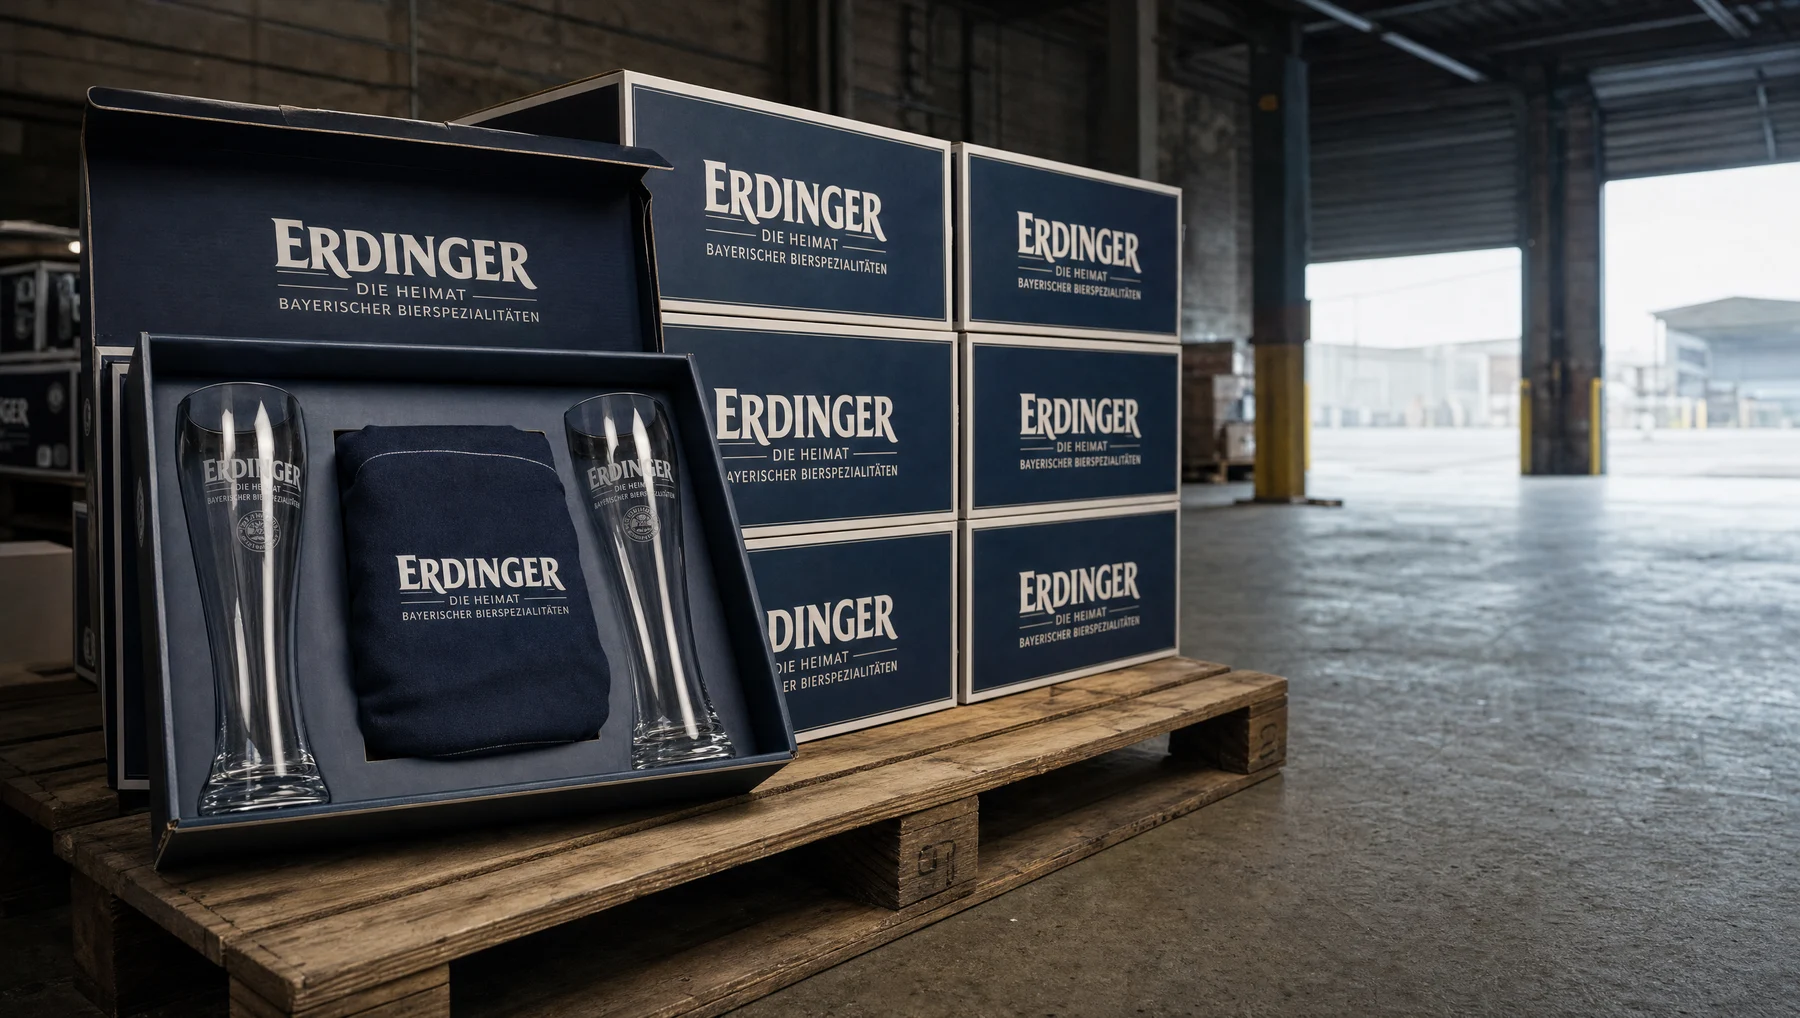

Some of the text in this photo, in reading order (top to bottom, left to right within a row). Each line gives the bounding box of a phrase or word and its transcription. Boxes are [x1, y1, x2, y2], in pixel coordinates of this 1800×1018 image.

[703, 159, 887, 242] ERDINGER
[762, 229, 838, 250] DIE HEIMAT
[1017, 211, 1142, 274] ERDINGER
[271, 218, 537, 290] ERDINGER
[707, 243, 887, 275] BAYERISCHER BIERSPEZIALITÄTEN
[1056, 265, 1107, 282] DIE HEIMAT
[357, 283, 466, 300] DIE HEIMAT
[1018, 278, 1141, 300] BAYERISCHER BIERSPEZIALITÄTEN
[279, 298, 539, 322] BAYERISCHER BIERSPEZIALITÄTEN
[714, 388, 898, 446] ERDINGER
[1020, 393, 1142, 440] ERDINGER
[773, 448, 849, 461] DIE HEIMAT
[1057, 441, 1108, 452] DIE HEIMAT
[1020, 453, 1141, 470] BAYERISCHER BIERSPEZIALITÄTEN
[727, 463, 897, 483] AYERISCHER BIERSPEZIALITÄTEN
[614, 484, 626, 492] DIE
[395, 555, 566, 594] ERDINGER
[1019, 561, 1140, 615] ERDINGER
[450, 594, 520, 606] DIE HEIMAT
[402, 605, 569, 621] BAYERISCHER BIERSPEZIALITÄTEN
[767, 595, 898, 653] DINGER
[1056, 606, 1107, 625] DIE HEIMAT
[1019, 615, 1140, 648] BAYERISCHER BIERSPEZIALITÄTEN
[801, 651, 849, 670] HEIMAT
[801, 660, 897, 689] BIERSPEZIALITÄTEN
